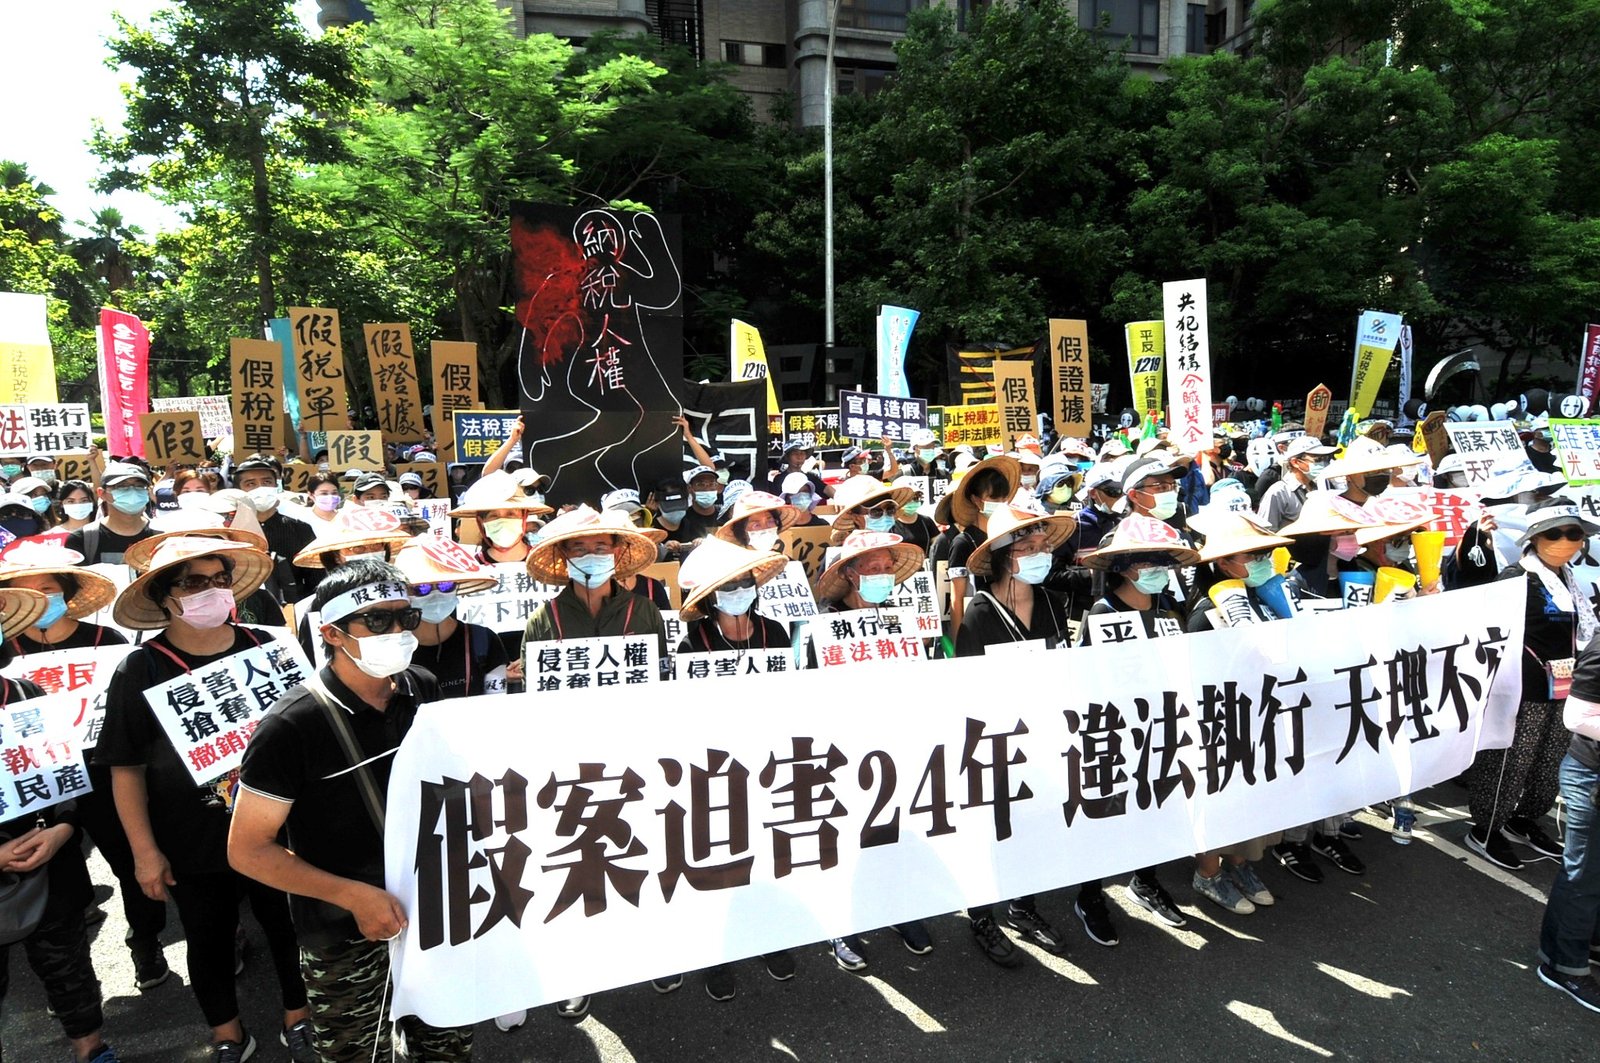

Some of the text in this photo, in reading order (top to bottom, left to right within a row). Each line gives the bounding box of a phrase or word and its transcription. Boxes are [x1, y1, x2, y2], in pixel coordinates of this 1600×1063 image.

[581, 219, 632, 396] 納稅人權
[1139, 329, 1154, 353] 平反
[295, 313, 343, 431] 假稅單
[370, 329, 420, 436] 假證據
[1056, 335, 1086, 424] 假證據
[29, 407, 86, 428] 強行
[239, 359, 276, 453] 假稅單
[846, 395, 921, 420] 官員造假
[33, 431, 90, 452] 拍賣
[147, 419, 202, 459] 假
[846, 416, 921, 441] 毒害全國
[1453, 428, 1522, 453] 假案不撤
[331, 434, 380, 465] 假
[888, 576, 931, 595] 人權
[463, 601, 549, 624] 必下地
[761, 602, 817, 618] 下地獄
[830, 614, 903, 641] 執行署
[537, 642, 649, 673] 侵害人權
[822, 636, 919, 667] 違法執行
[166, 647, 298, 716] 侵害人權
[687, 655, 786, 679] 侵害人權
[415, 716, 1034, 951] 假案迫害24年
[1062, 667, 1312, 829] 違法執行
